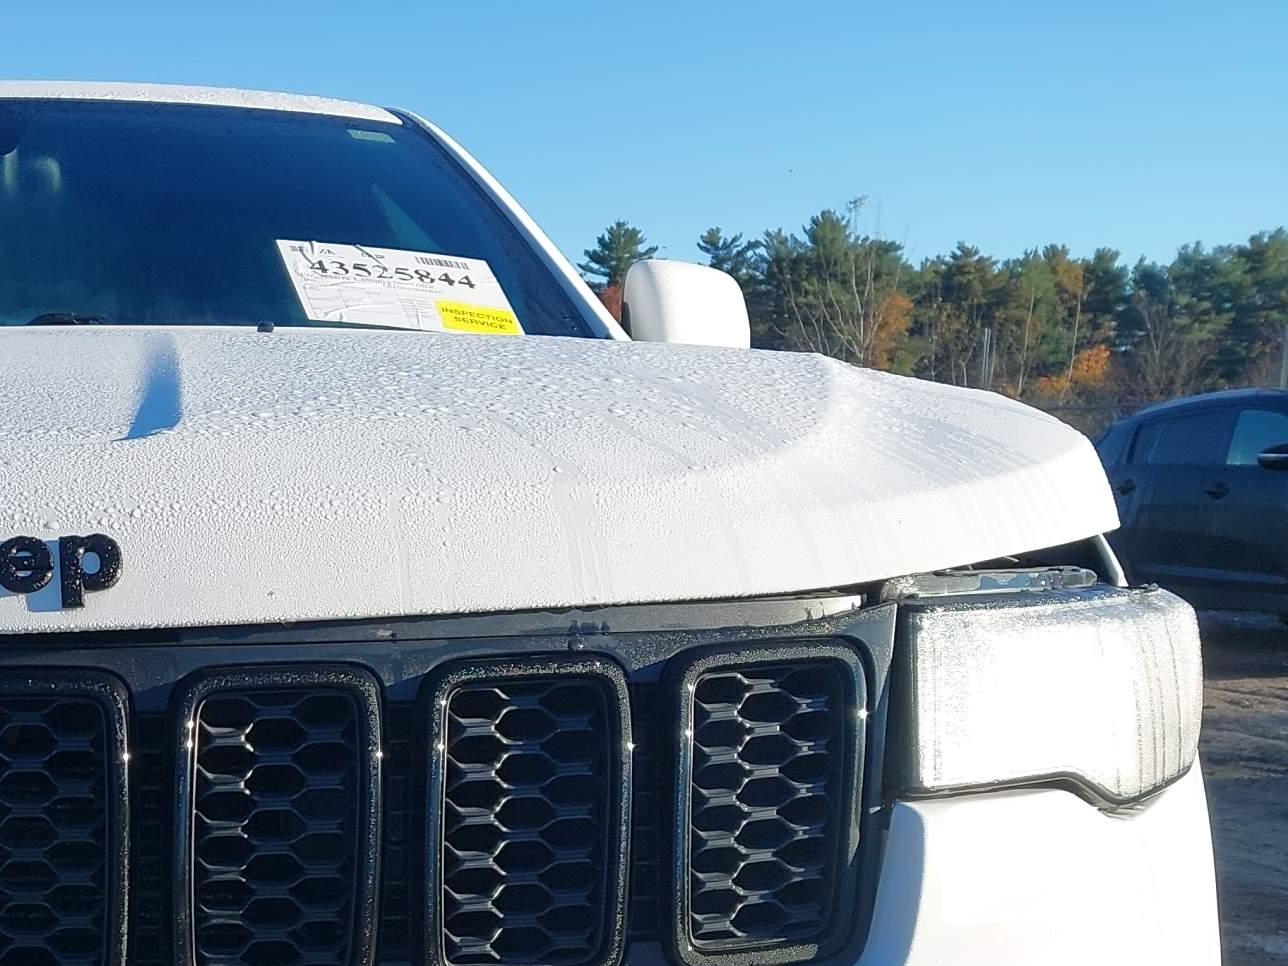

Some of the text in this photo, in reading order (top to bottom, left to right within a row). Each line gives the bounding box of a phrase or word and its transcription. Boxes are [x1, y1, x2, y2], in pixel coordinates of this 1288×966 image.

[310, 259, 476, 289] 43525844
[441, 307, 513, 324] INSPECTION
[453, 316, 507, 330] SERVICE
